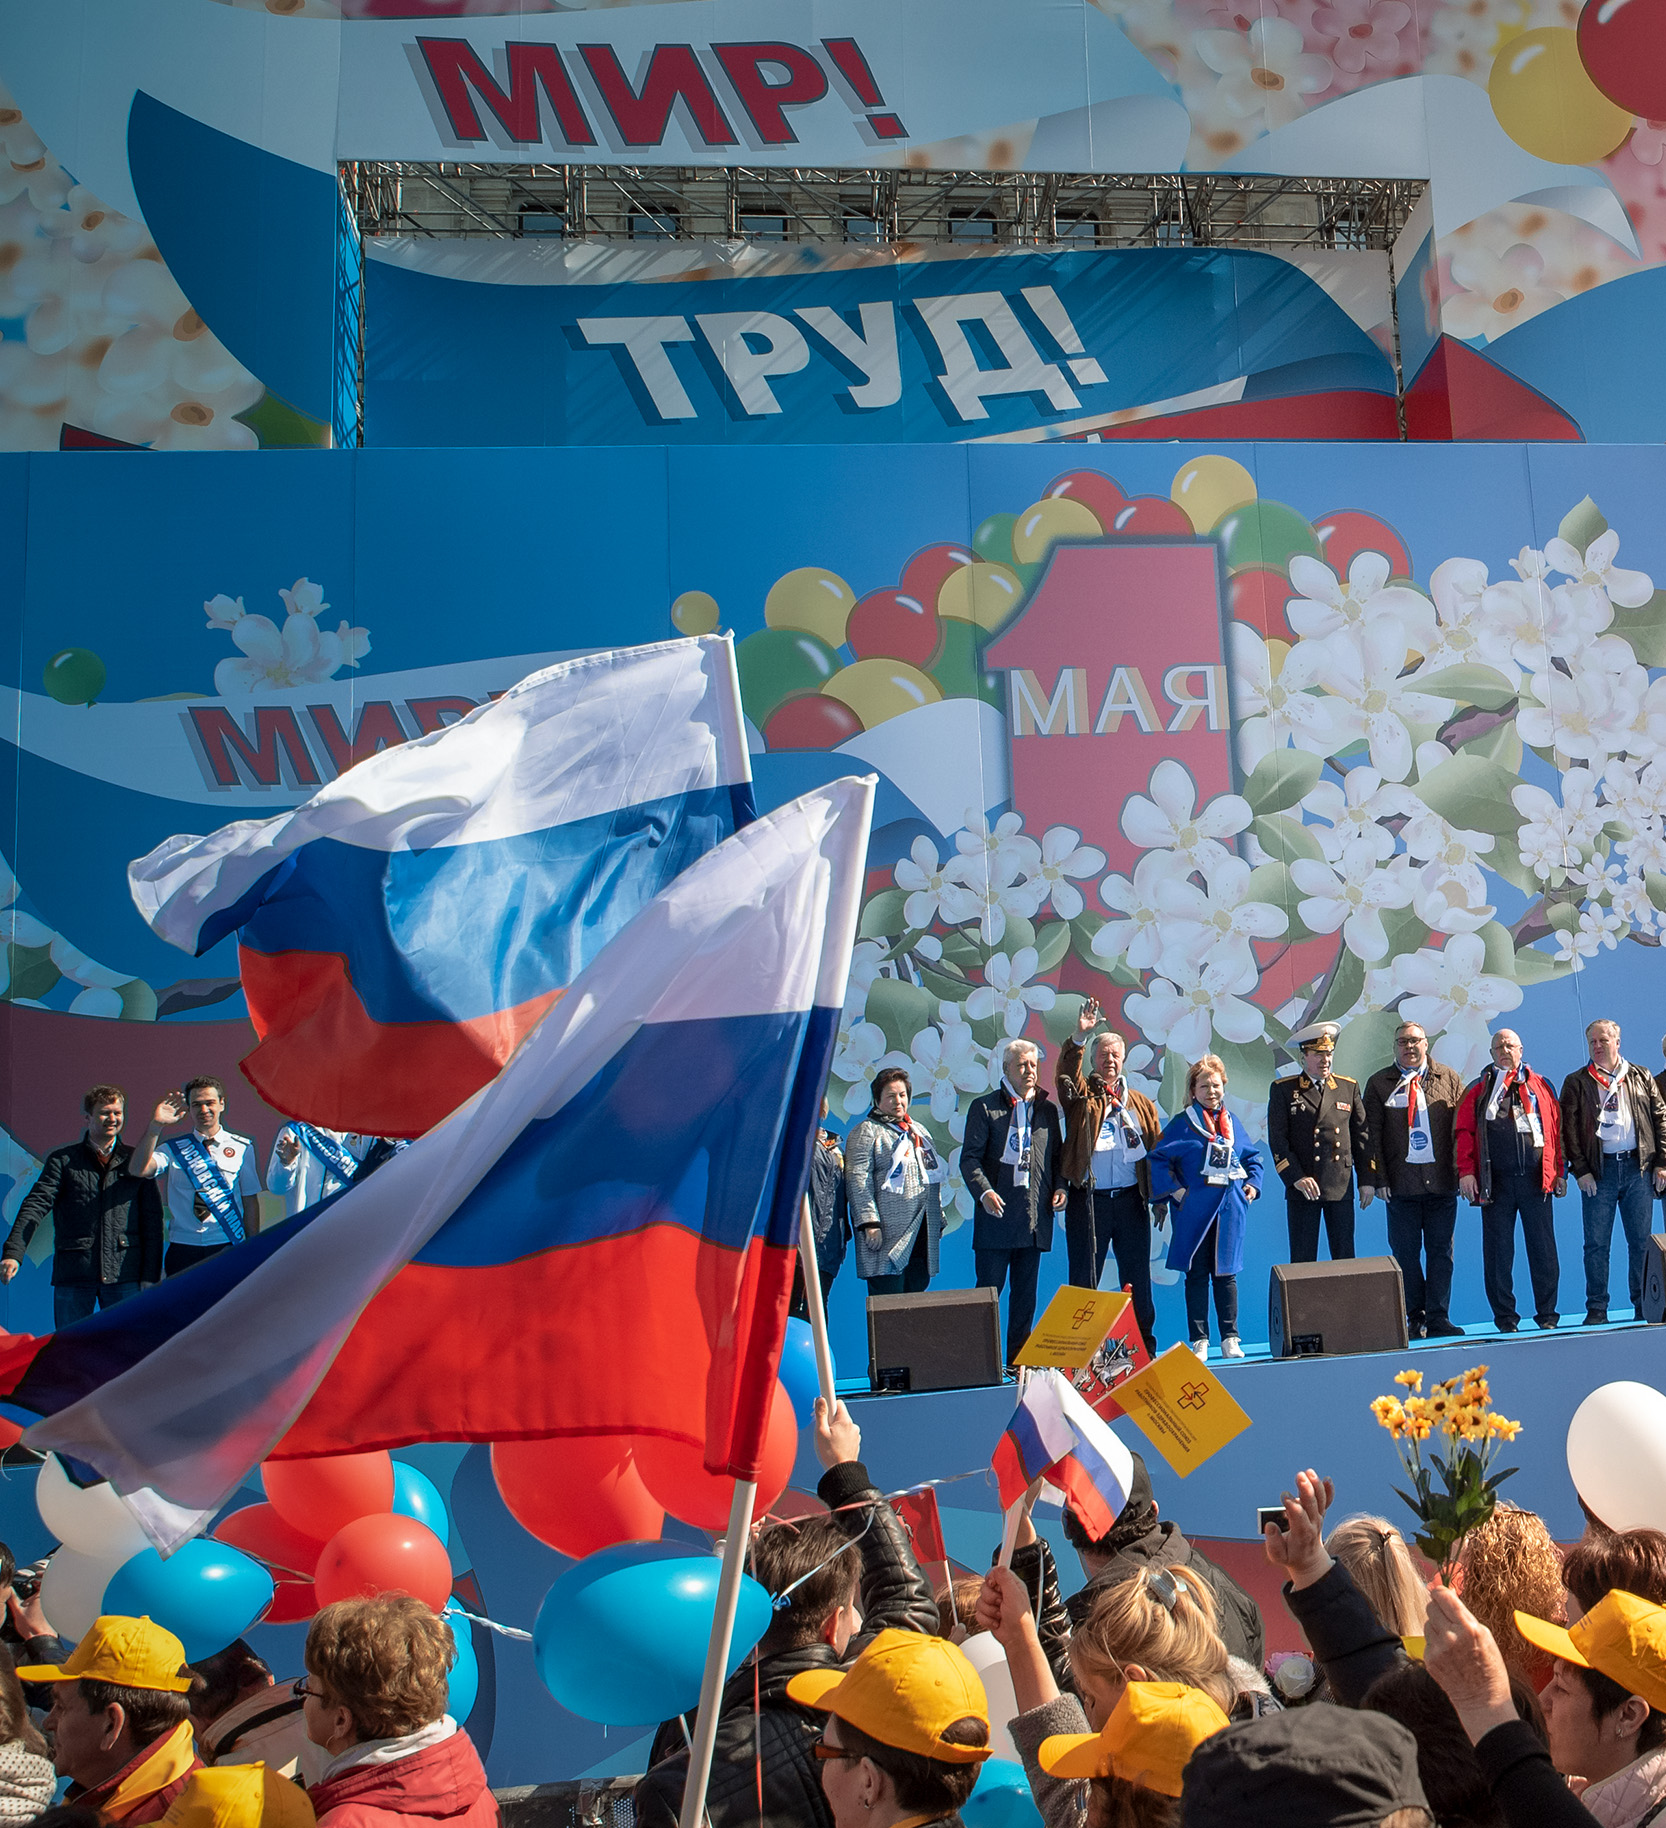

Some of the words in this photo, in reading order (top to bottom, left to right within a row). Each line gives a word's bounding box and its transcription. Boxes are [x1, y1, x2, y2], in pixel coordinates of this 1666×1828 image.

[414, 35, 910, 147] МИР!
[576, 285, 1110, 421] ТРУД!
[1009, 664, 1231, 737] МАЯ
[174, 1137, 231, 1214] МОСКОВСКИЙ
